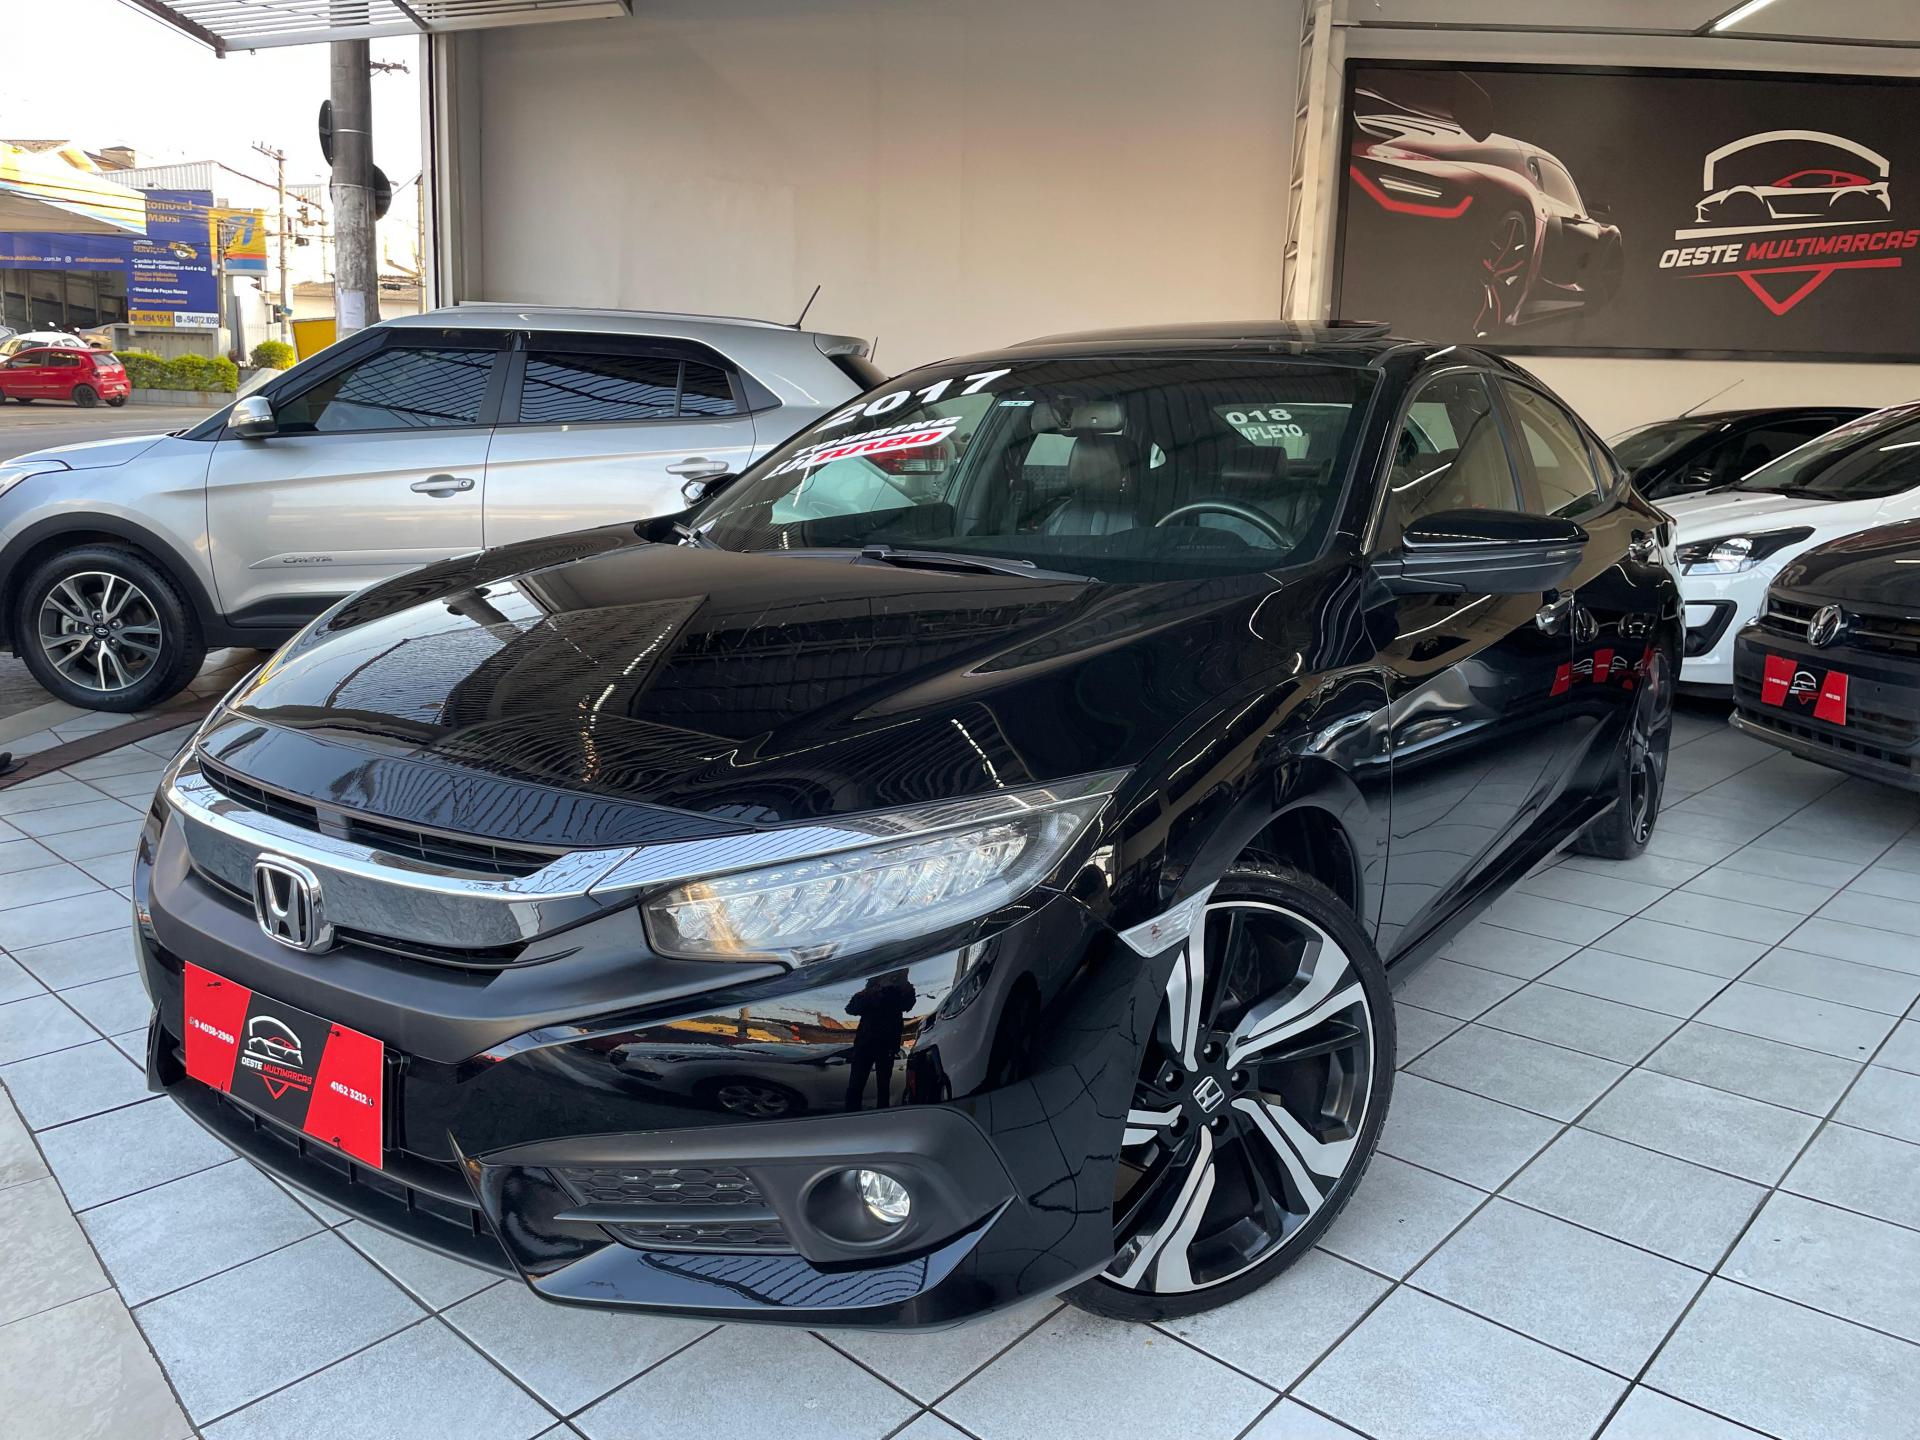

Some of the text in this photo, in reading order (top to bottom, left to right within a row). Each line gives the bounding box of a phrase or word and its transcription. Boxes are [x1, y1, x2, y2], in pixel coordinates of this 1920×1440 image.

[1658, 229, 1920, 269] OESTE MULTIMARCAS
[814, 368, 1011, 433] 2017
[814, 431, 943, 463] TURBO
[241, 1056, 313, 1085] OESTE MULTIMARCAS
[330, 1080, 368, 1105] 4162 3212
